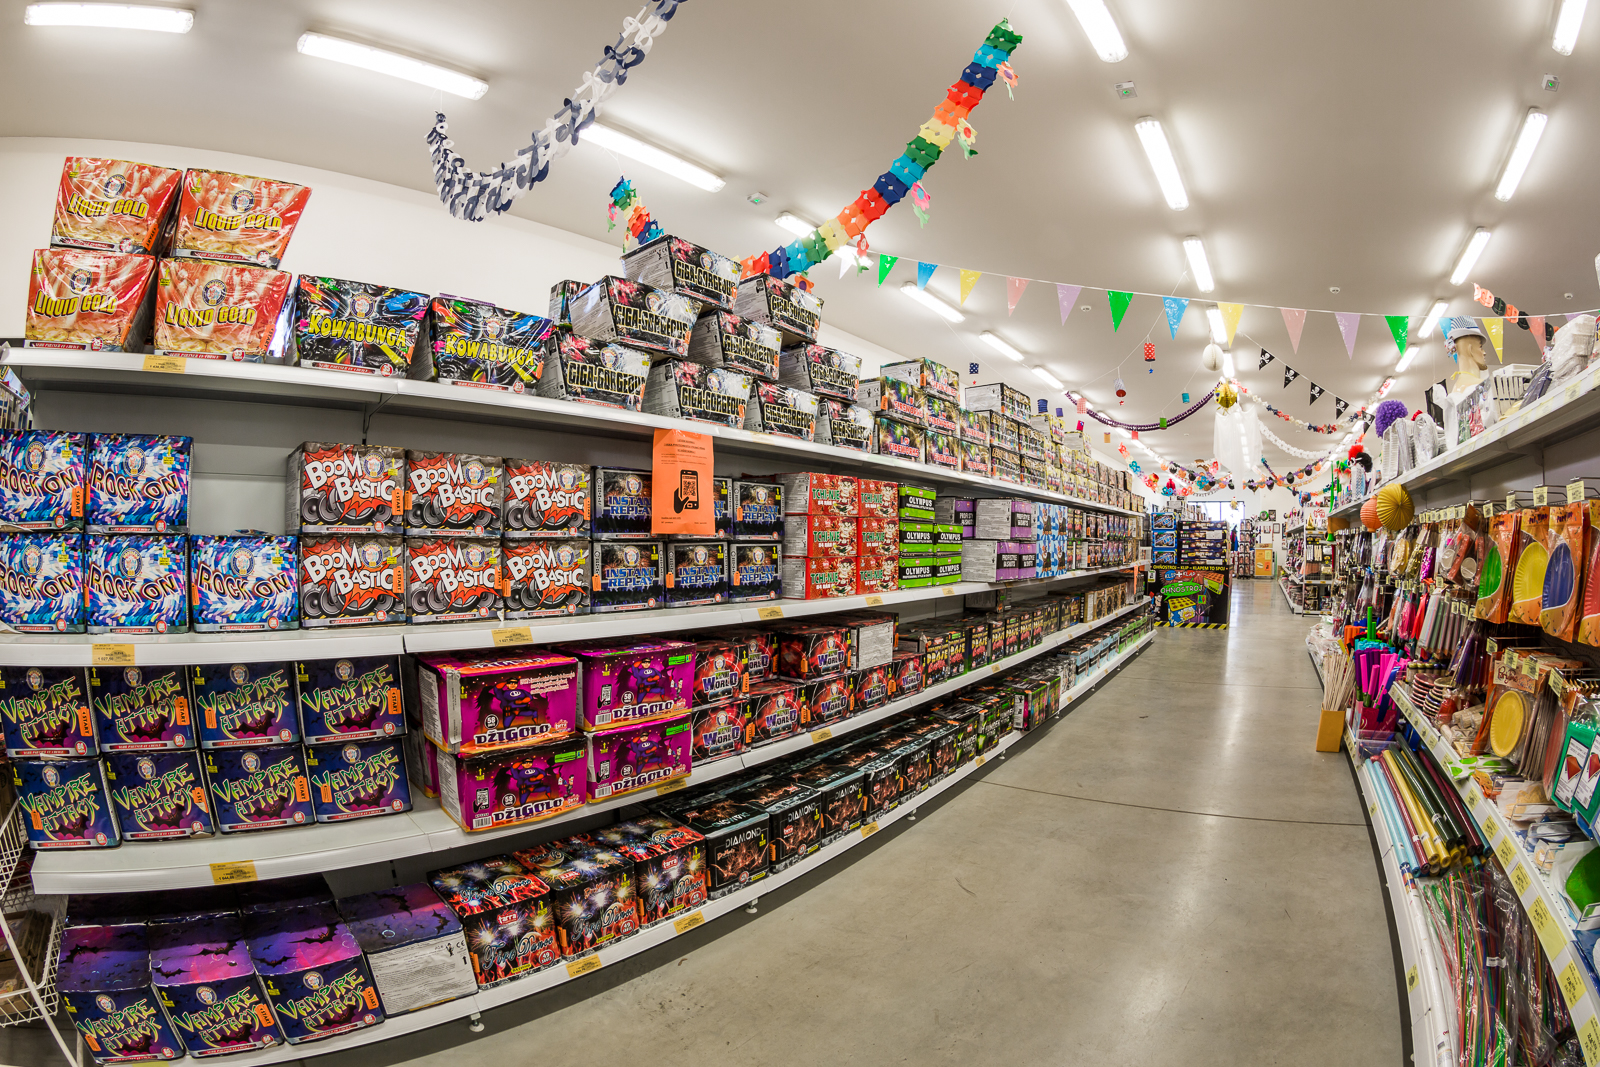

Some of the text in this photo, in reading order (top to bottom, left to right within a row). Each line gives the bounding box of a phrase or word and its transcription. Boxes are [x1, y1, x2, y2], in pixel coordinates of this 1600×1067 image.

[66, 193, 150, 219] LIQUID GOLD
[193, 206, 283, 233] LIQUID GOLD
[34, 290, 118, 317] LIQUID GOLD
[165, 302, 257, 329] LIQUID GOLD
[308, 314, 406, 347] KOWABUNGA
[445, 334, 534, 366] KOWABUNGA
[889, 442, 919, 457] FIREWORKS
[44, 467, 81, 497] ON
[90, 463, 181, 502] ROCK ON
[305, 451, 363, 489] BOOM
[410, 460, 464, 494] BOOM
[509, 467, 559, 500] BOOM
[334, 477, 395, 503] BASTIC
[438, 485, 495, 508] BASTIC
[535, 490, 585, 511] BASTIC
[608, 496, 652, 506] INSTAN
[909, 496, 932, 507] OLYMPUS
[744, 513, 777, 521] REPLAY
[906, 532, 930, 540] OLYMPUS
[940, 532, 961, 540] OLYMPUS
[303, 543, 362, 584] BOOM
[411, 545, 465, 582] BOOM
[506, 546, 556, 580] BOOM
[741, 573, 772, 582] REPLAY
[905, 566, 930, 575] OLYMPUS
[939, 564, 960, 573] OLYMPUS
[42, 572, 79, 601] ON
[89, 563, 181, 602] ROCK ON
[199, 563, 292, 602] ROCK ON
[333, 569, 393, 595] BASTIC
[440, 568, 496, 592] BASTIC
[533, 568, 584, 591] BASTIC
[608, 577, 654, 587] REPLAY
[681, 574, 720, 585] REPLAY
[1160, 585, 1203, 594] OHŇOSTROJ
[750, 655, 769, 668] ORLD
[818, 650, 844, 667] WORLD
[95, 672, 180, 719] VAMPIRE
[197, 669, 288, 714] VAMPIRE
[300, 664, 393, 712] VAMPIRE
[702, 672, 738, 693] WORLD
[1, 676, 81, 723] VAMPIRE
[324, 686, 389, 735] ATTACK
[612, 700, 674, 719] DŽIGOLO
[20, 700, 79, 748] ATTACK
[115, 696, 177, 743] ATTACK
[220, 692, 289, 739] ATTACK
[766, 709, 797, 729] WORLD
[474, 724, 551, 745] DŽIGOLO
[702, 726, 740, 748] WORLD
[212, 756, 299, 802] VAMPIRE
[311, 746, 398, 787] VAMPIRE
[612, 767, 673, 791] DŽIGOLO
[19, 772, 97, 815] VAMPIRE
[112, 763, 195, 810] VAMPIRE
[236, 777, 296, 823] ATTACK
[335, 767, 400, 812] ATTACK
[834, 782, 860, 799] DIAMOND
[41, 795, 100, 840] ATTACK
[134, 785, 193, 831] ATTACK
[492, 798, 564, 822] DŽIGOLO
[788, 803, 816, 822] DIAMOND
[725, 827, 761, 848] DIAMOND
[646, 878, 703, 911] Fire Dance
[571, 907, 634, 941] Fire Dance
[482, 935, 553, 970] Fire Dance
[275, 968, 364, 1019] VAMPIRE
[76, 999, 156, 1038] VAMPIRE
[172, 986, 259, 1033] VAMPIRE
[261, 1010, 271, 1024] START
[303, 986, 364, 1032] ATTACK
[102, 1018, 161, 1057] ATTACK
[200, 1006, 258, 1054] ATTACK
